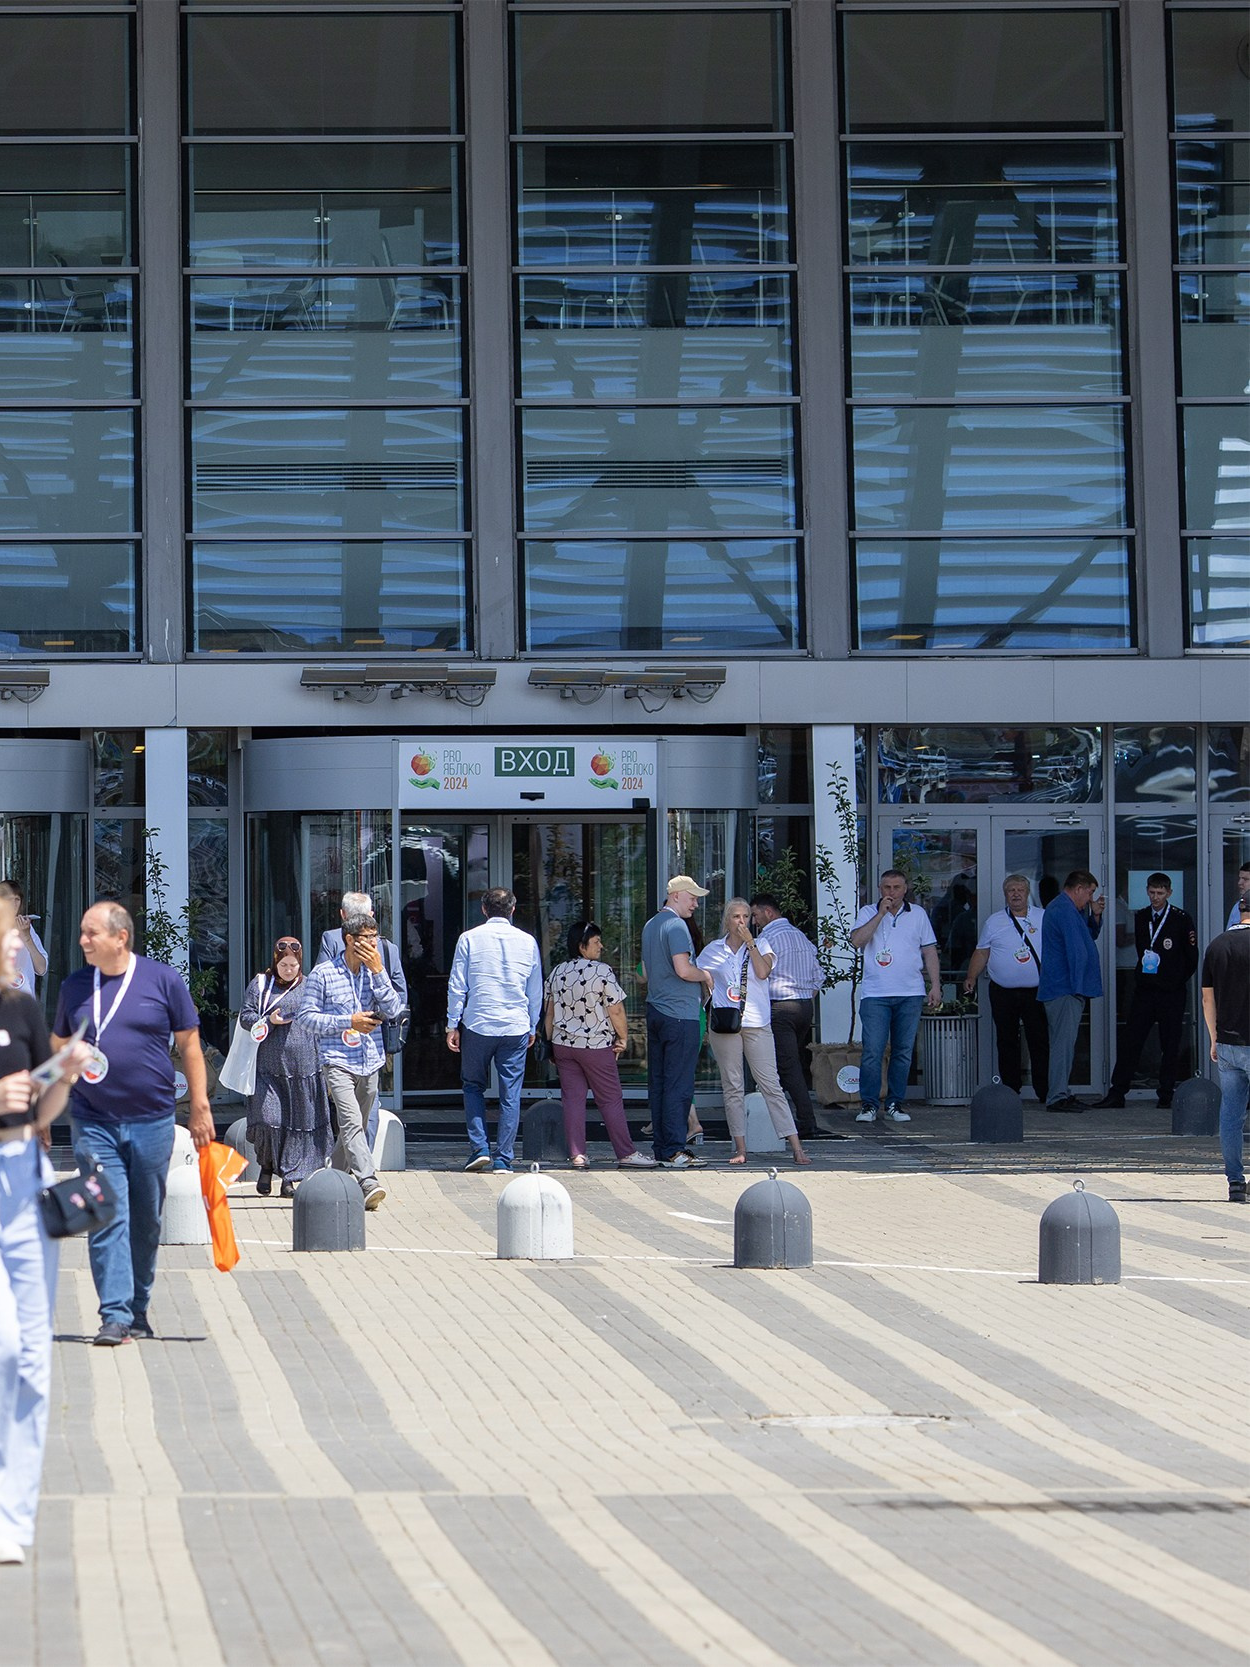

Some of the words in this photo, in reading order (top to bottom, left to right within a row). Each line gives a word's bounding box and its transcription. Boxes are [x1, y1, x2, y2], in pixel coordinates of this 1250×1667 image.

[443, 749, 462, 762] PRO
[500, 749, 570, 775] ВХОД
[621, 750, 638, 762] PRO
[443, 762, 482, 776] ЯБЛОКО
[621, 762, 654, 776] ЯБЛОКО
[443, 776, 468, 790] 2024
[621, 777, 644, 790] 2024
